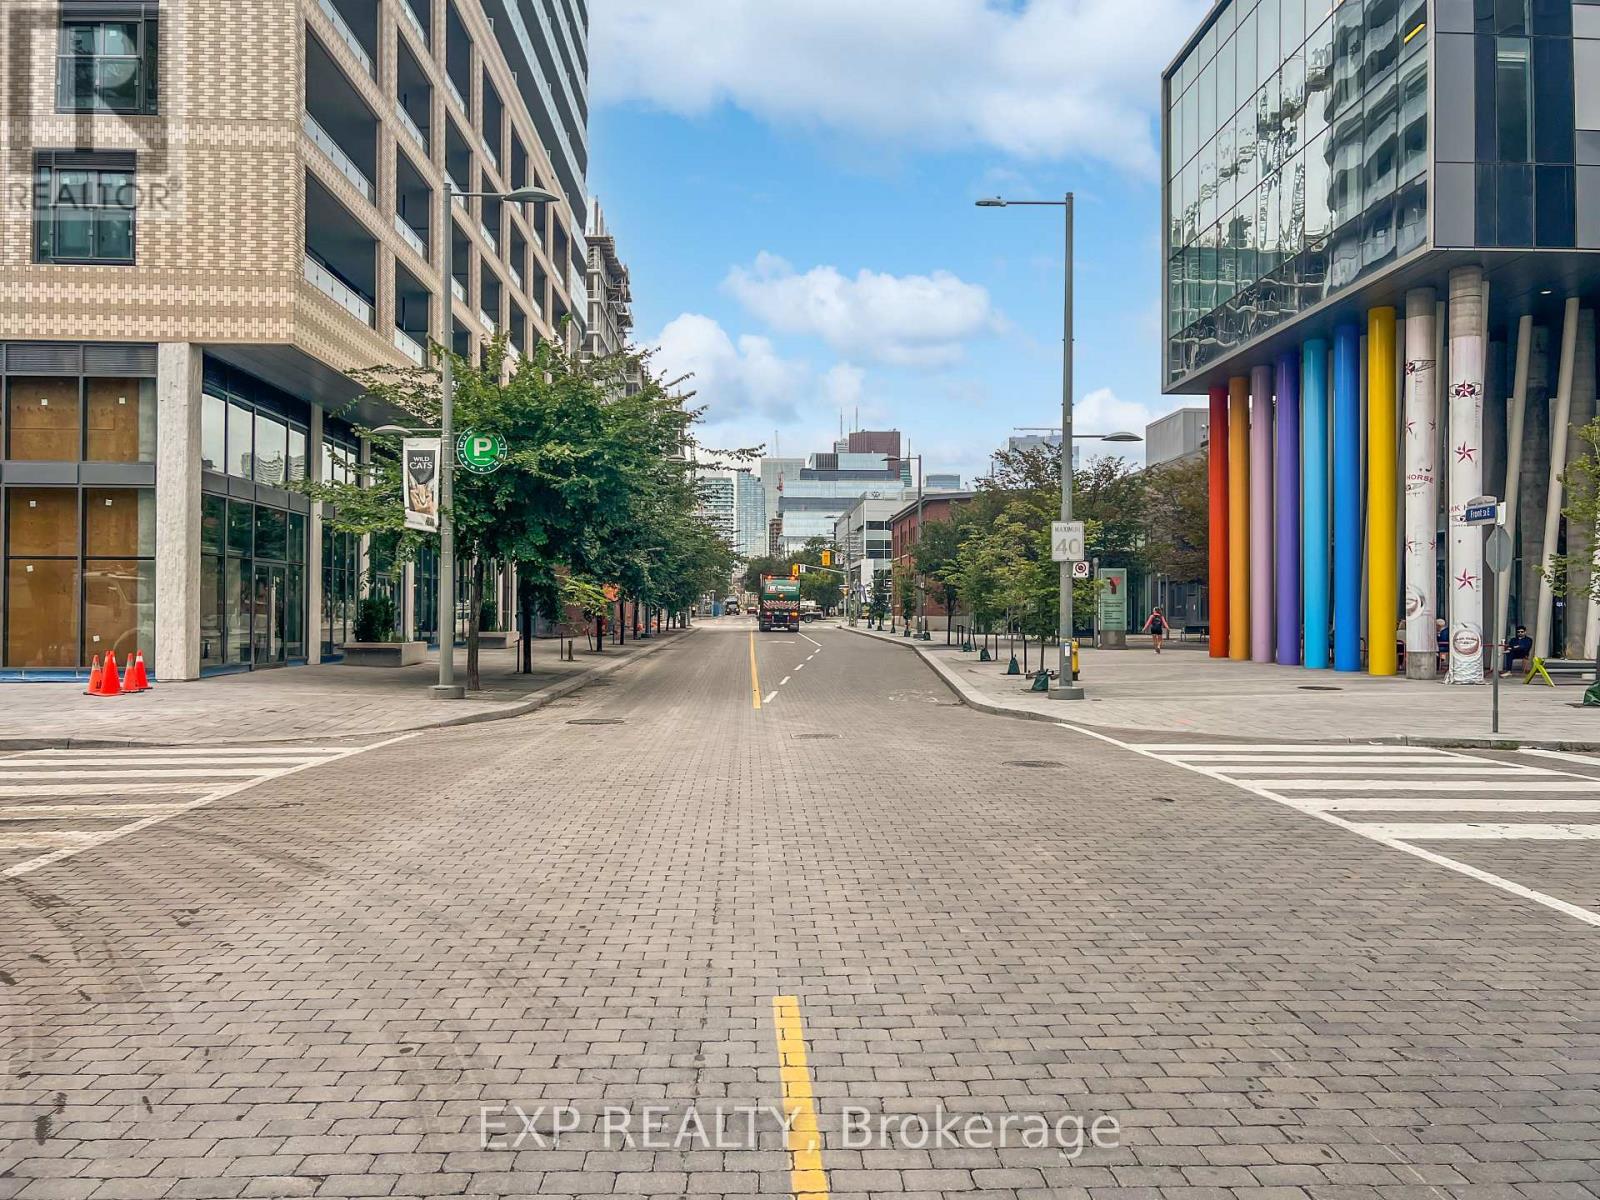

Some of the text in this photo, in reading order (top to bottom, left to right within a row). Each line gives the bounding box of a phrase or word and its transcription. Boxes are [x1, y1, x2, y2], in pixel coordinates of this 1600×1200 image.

[473, 437, 492, 457] P
[409, 461, 433, 470] CATS
[1055, 538, 1081, 556] 40
